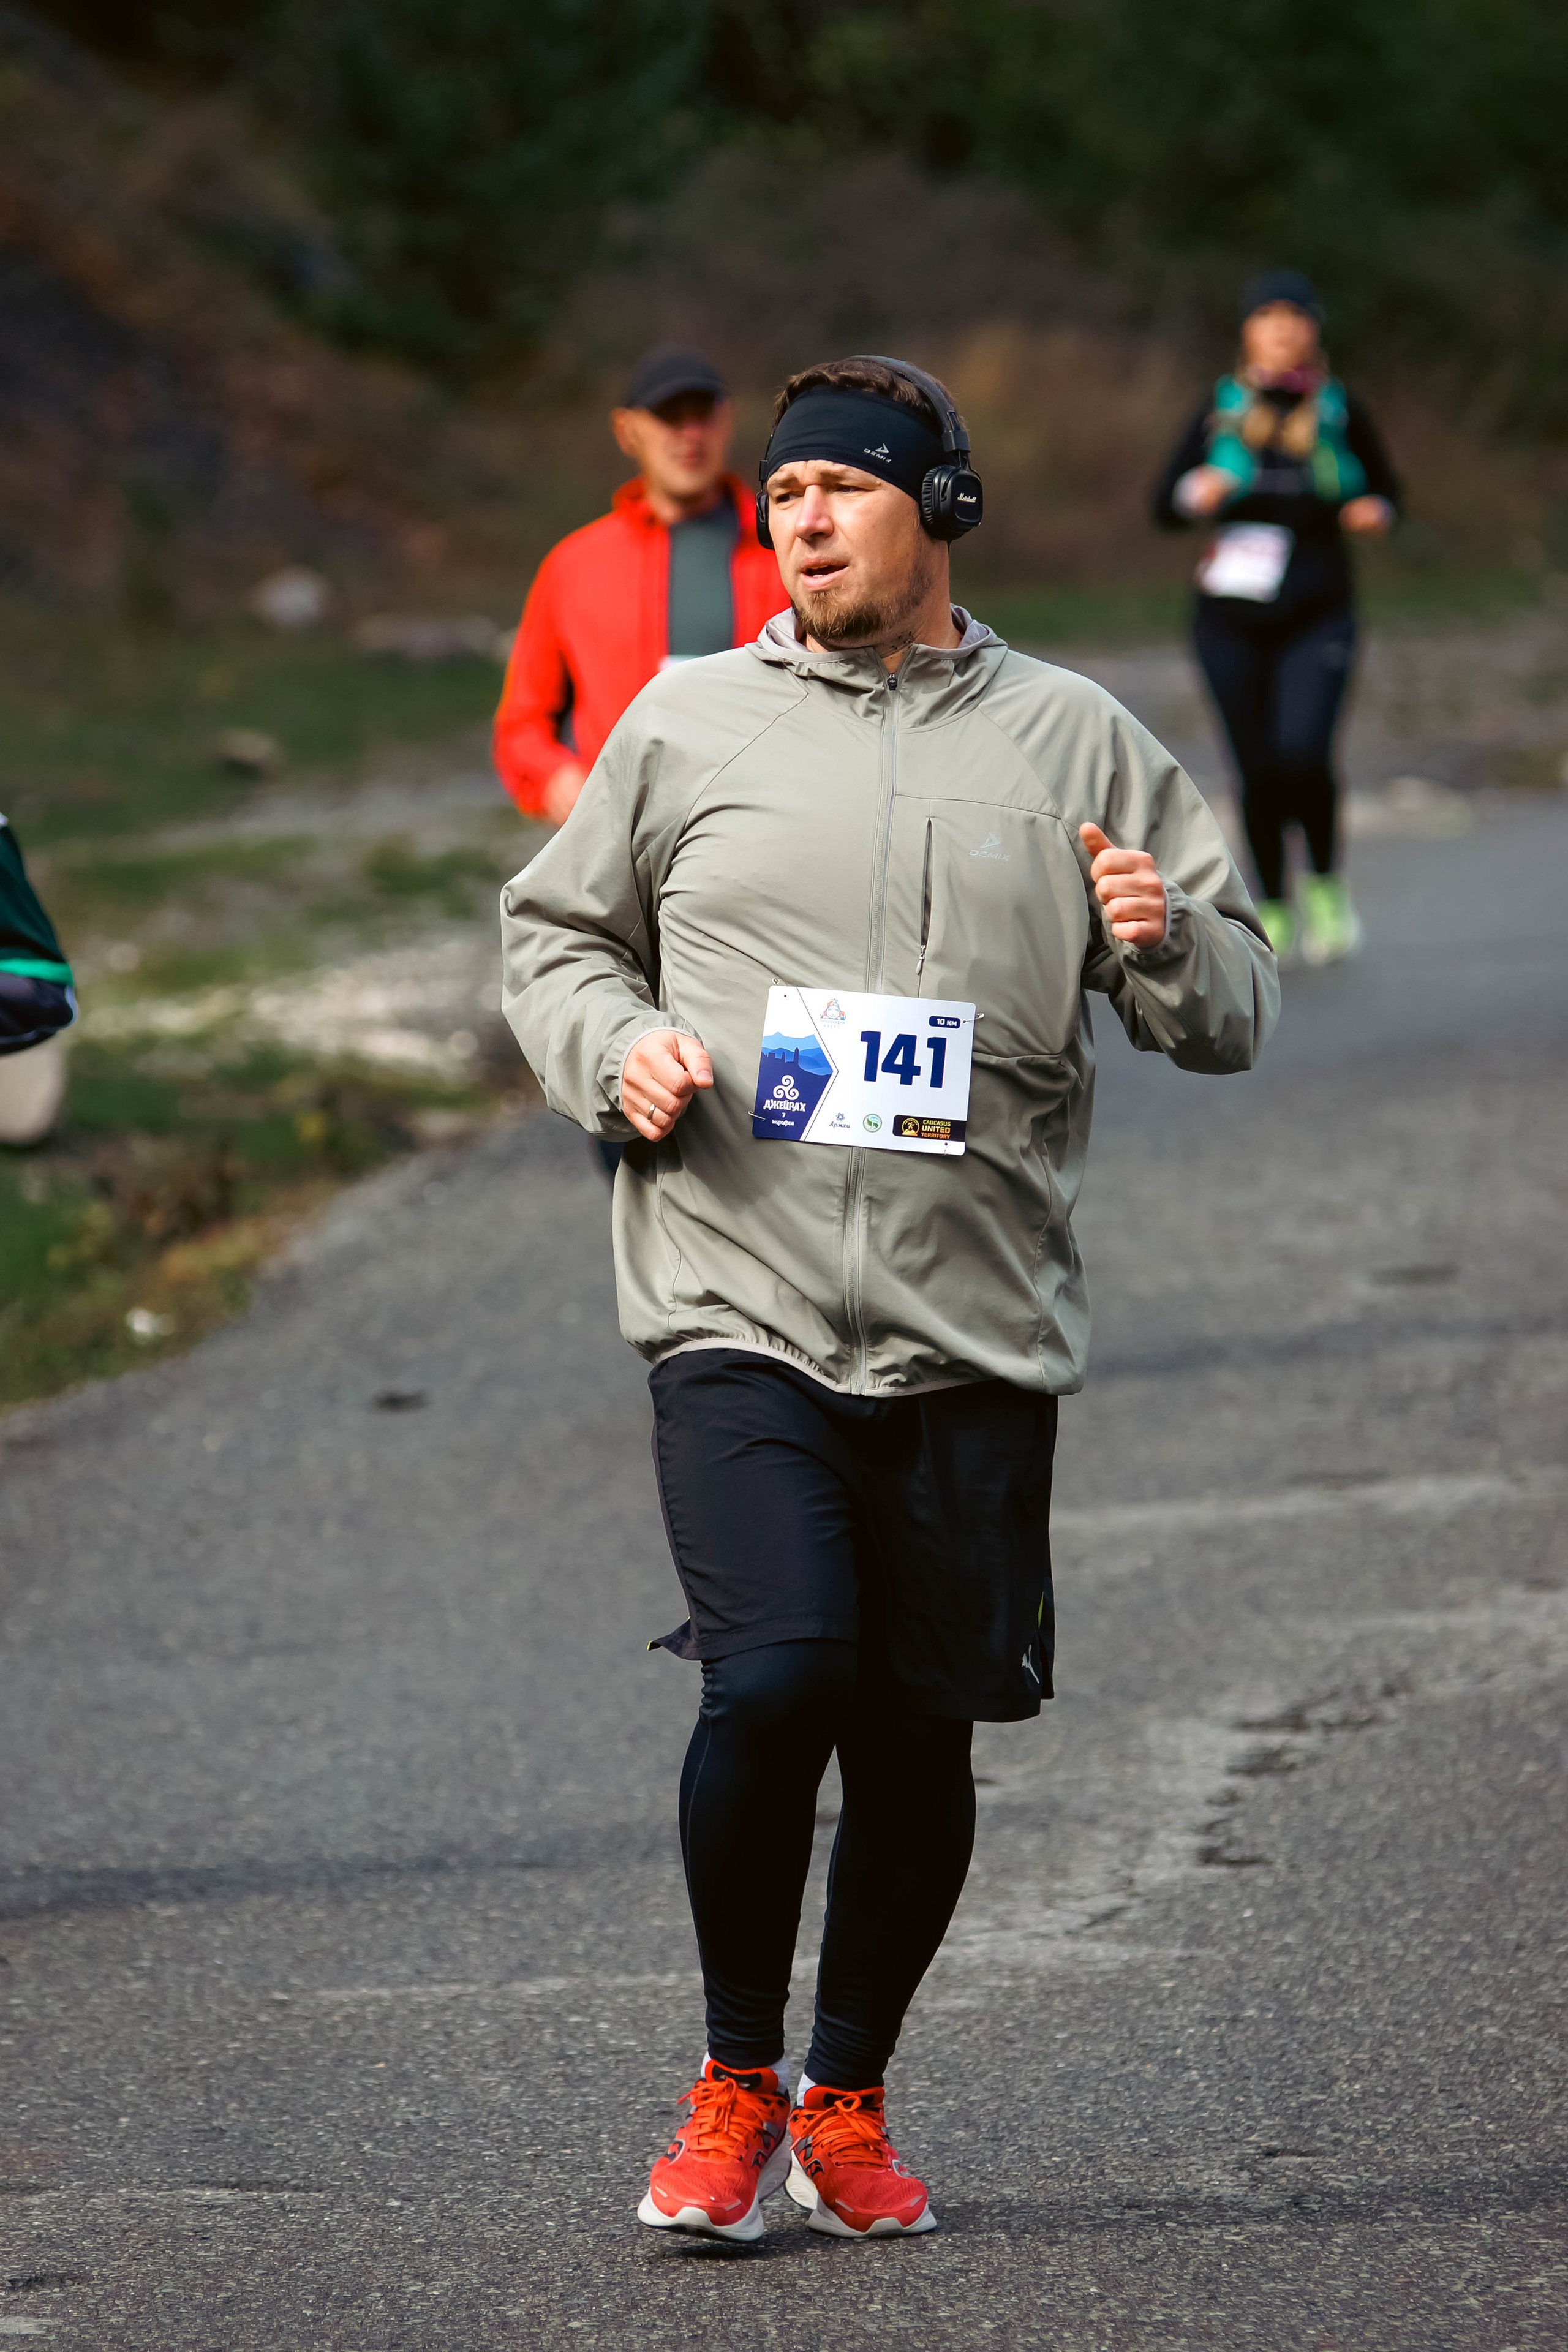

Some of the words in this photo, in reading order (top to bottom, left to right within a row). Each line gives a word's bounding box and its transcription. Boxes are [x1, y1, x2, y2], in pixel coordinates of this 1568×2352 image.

[969, 850, 1011, 861] DEMIX
[860, 1030, 947, 1088] 141
[763, 1099, 807, 1112] ДЖЕЙРАХ
